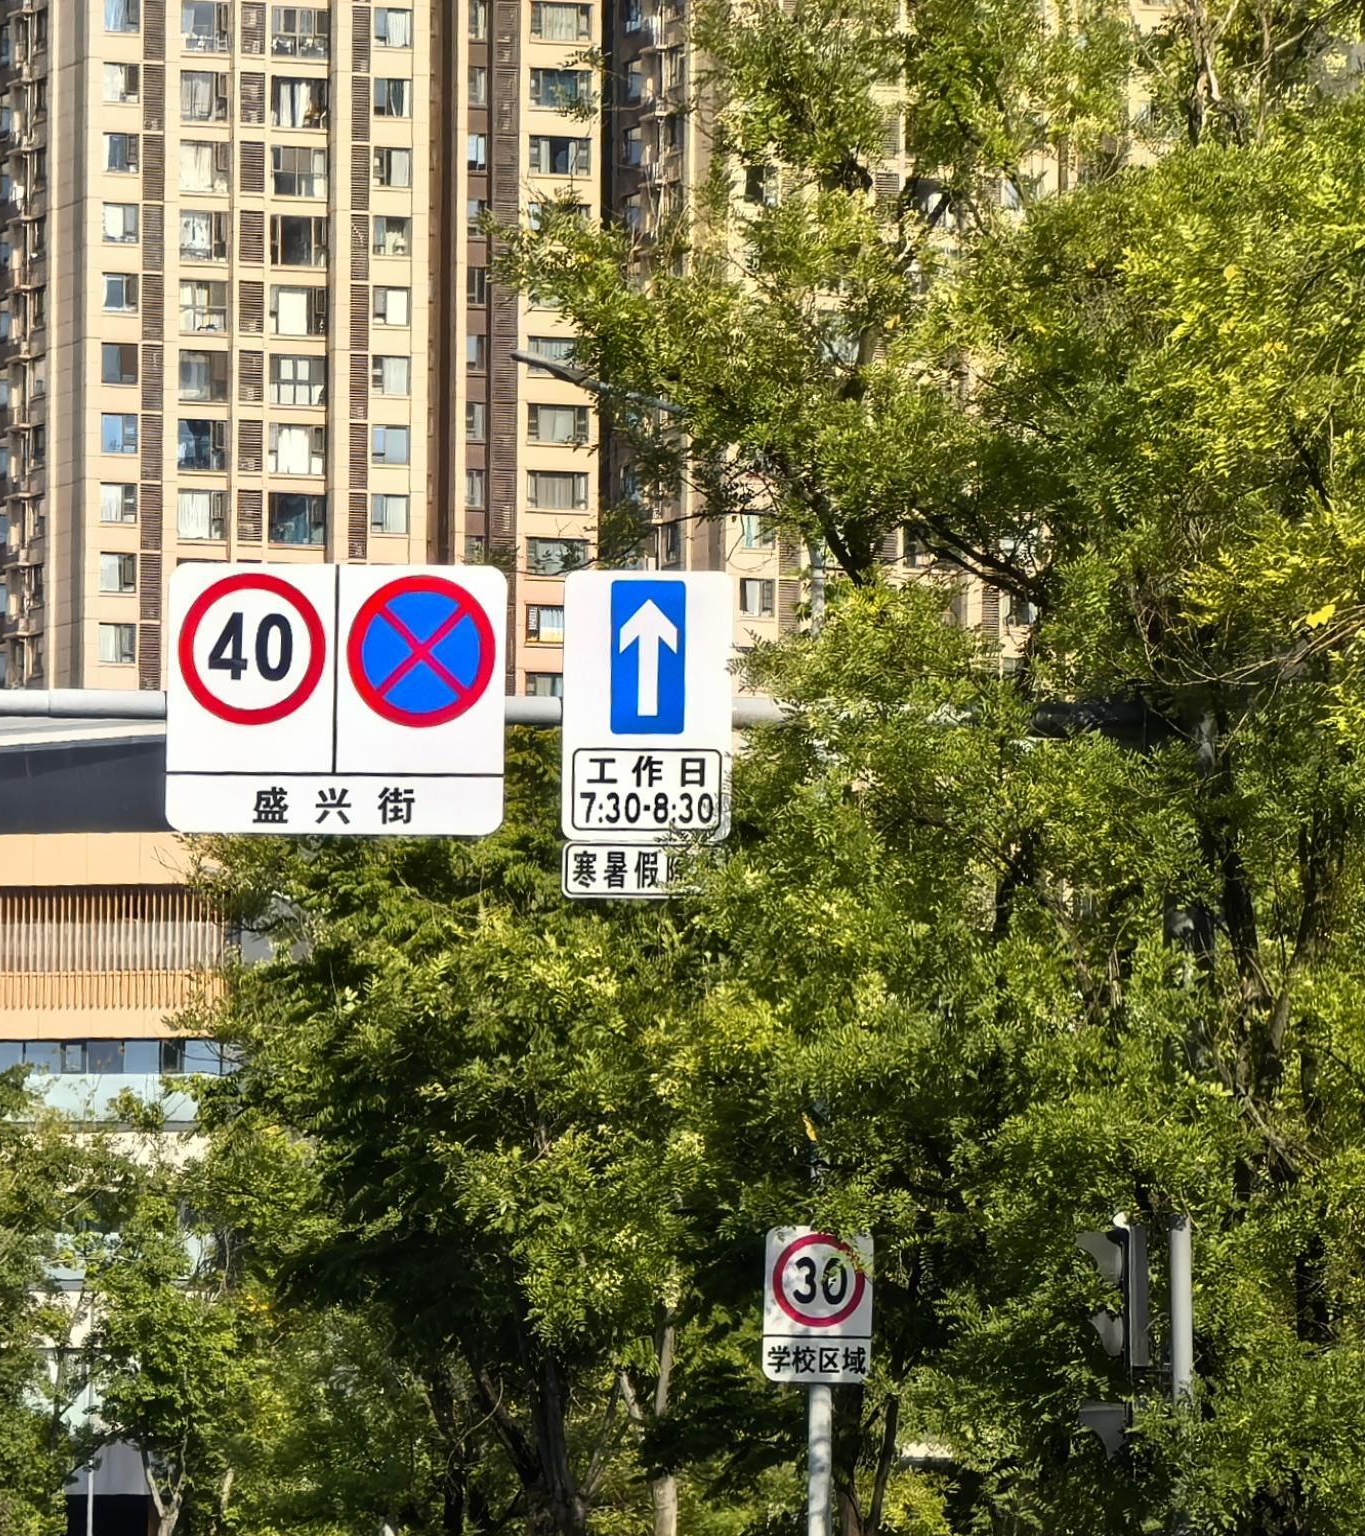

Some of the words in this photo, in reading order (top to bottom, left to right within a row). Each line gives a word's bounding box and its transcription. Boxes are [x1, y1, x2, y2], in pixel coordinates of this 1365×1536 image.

[207, 611, 294, 682] 40
[586, 755, 707, 788] 工作日
[252, 786, 416, 825] 盛兴街
[579, 792, 715, 824] 7:30-8:30
[792, 1256, 847, 1305] 30
[767, 1346, 866, 1374] 学校区域
